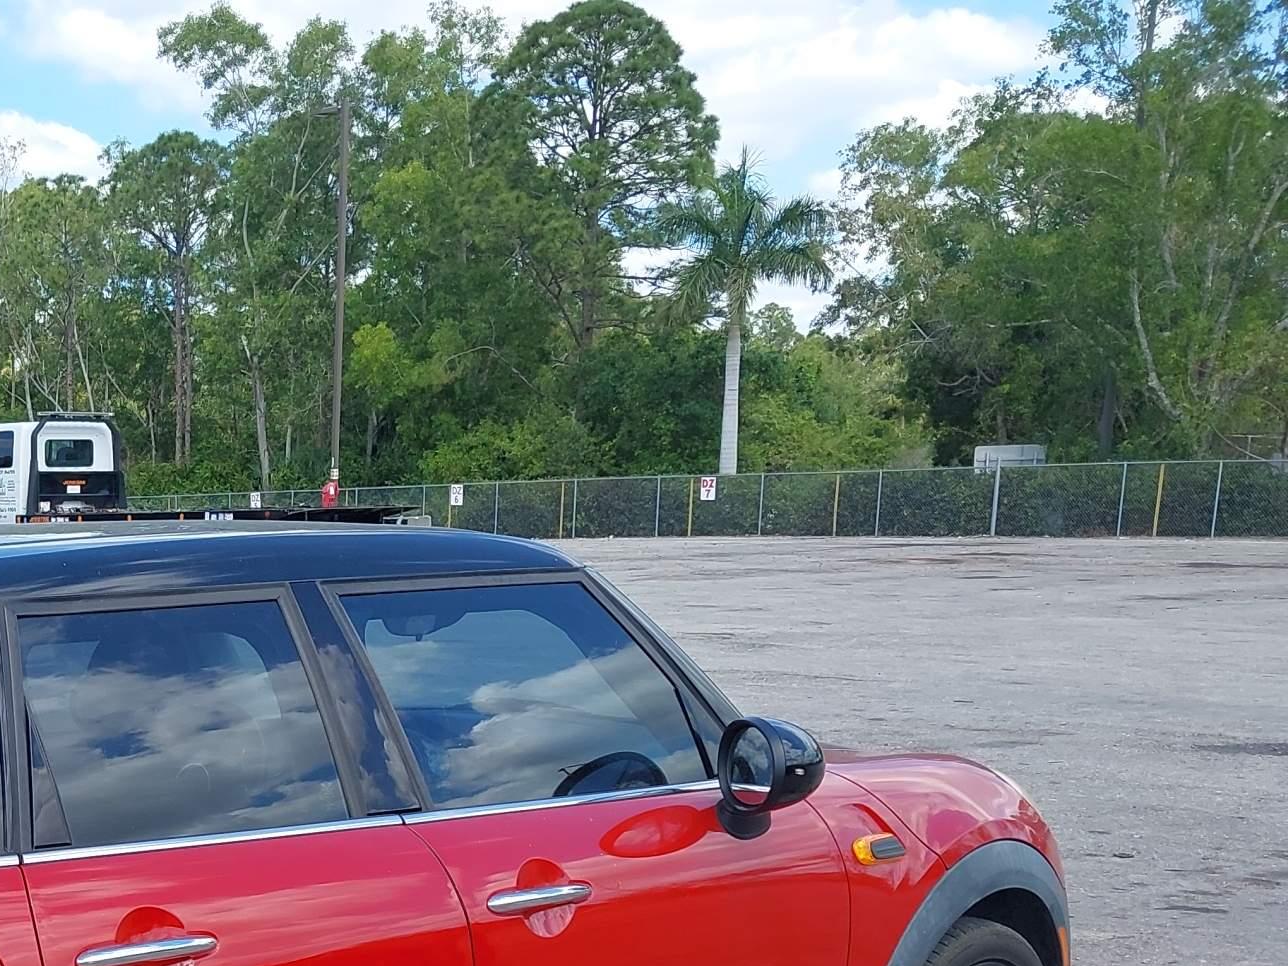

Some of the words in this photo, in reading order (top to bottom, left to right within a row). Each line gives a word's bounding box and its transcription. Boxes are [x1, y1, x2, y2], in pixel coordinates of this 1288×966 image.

[702, 478, 715, 489] DZ
[452, 486, 462, 495] DZ
[704, 489, 711, 499] 7
